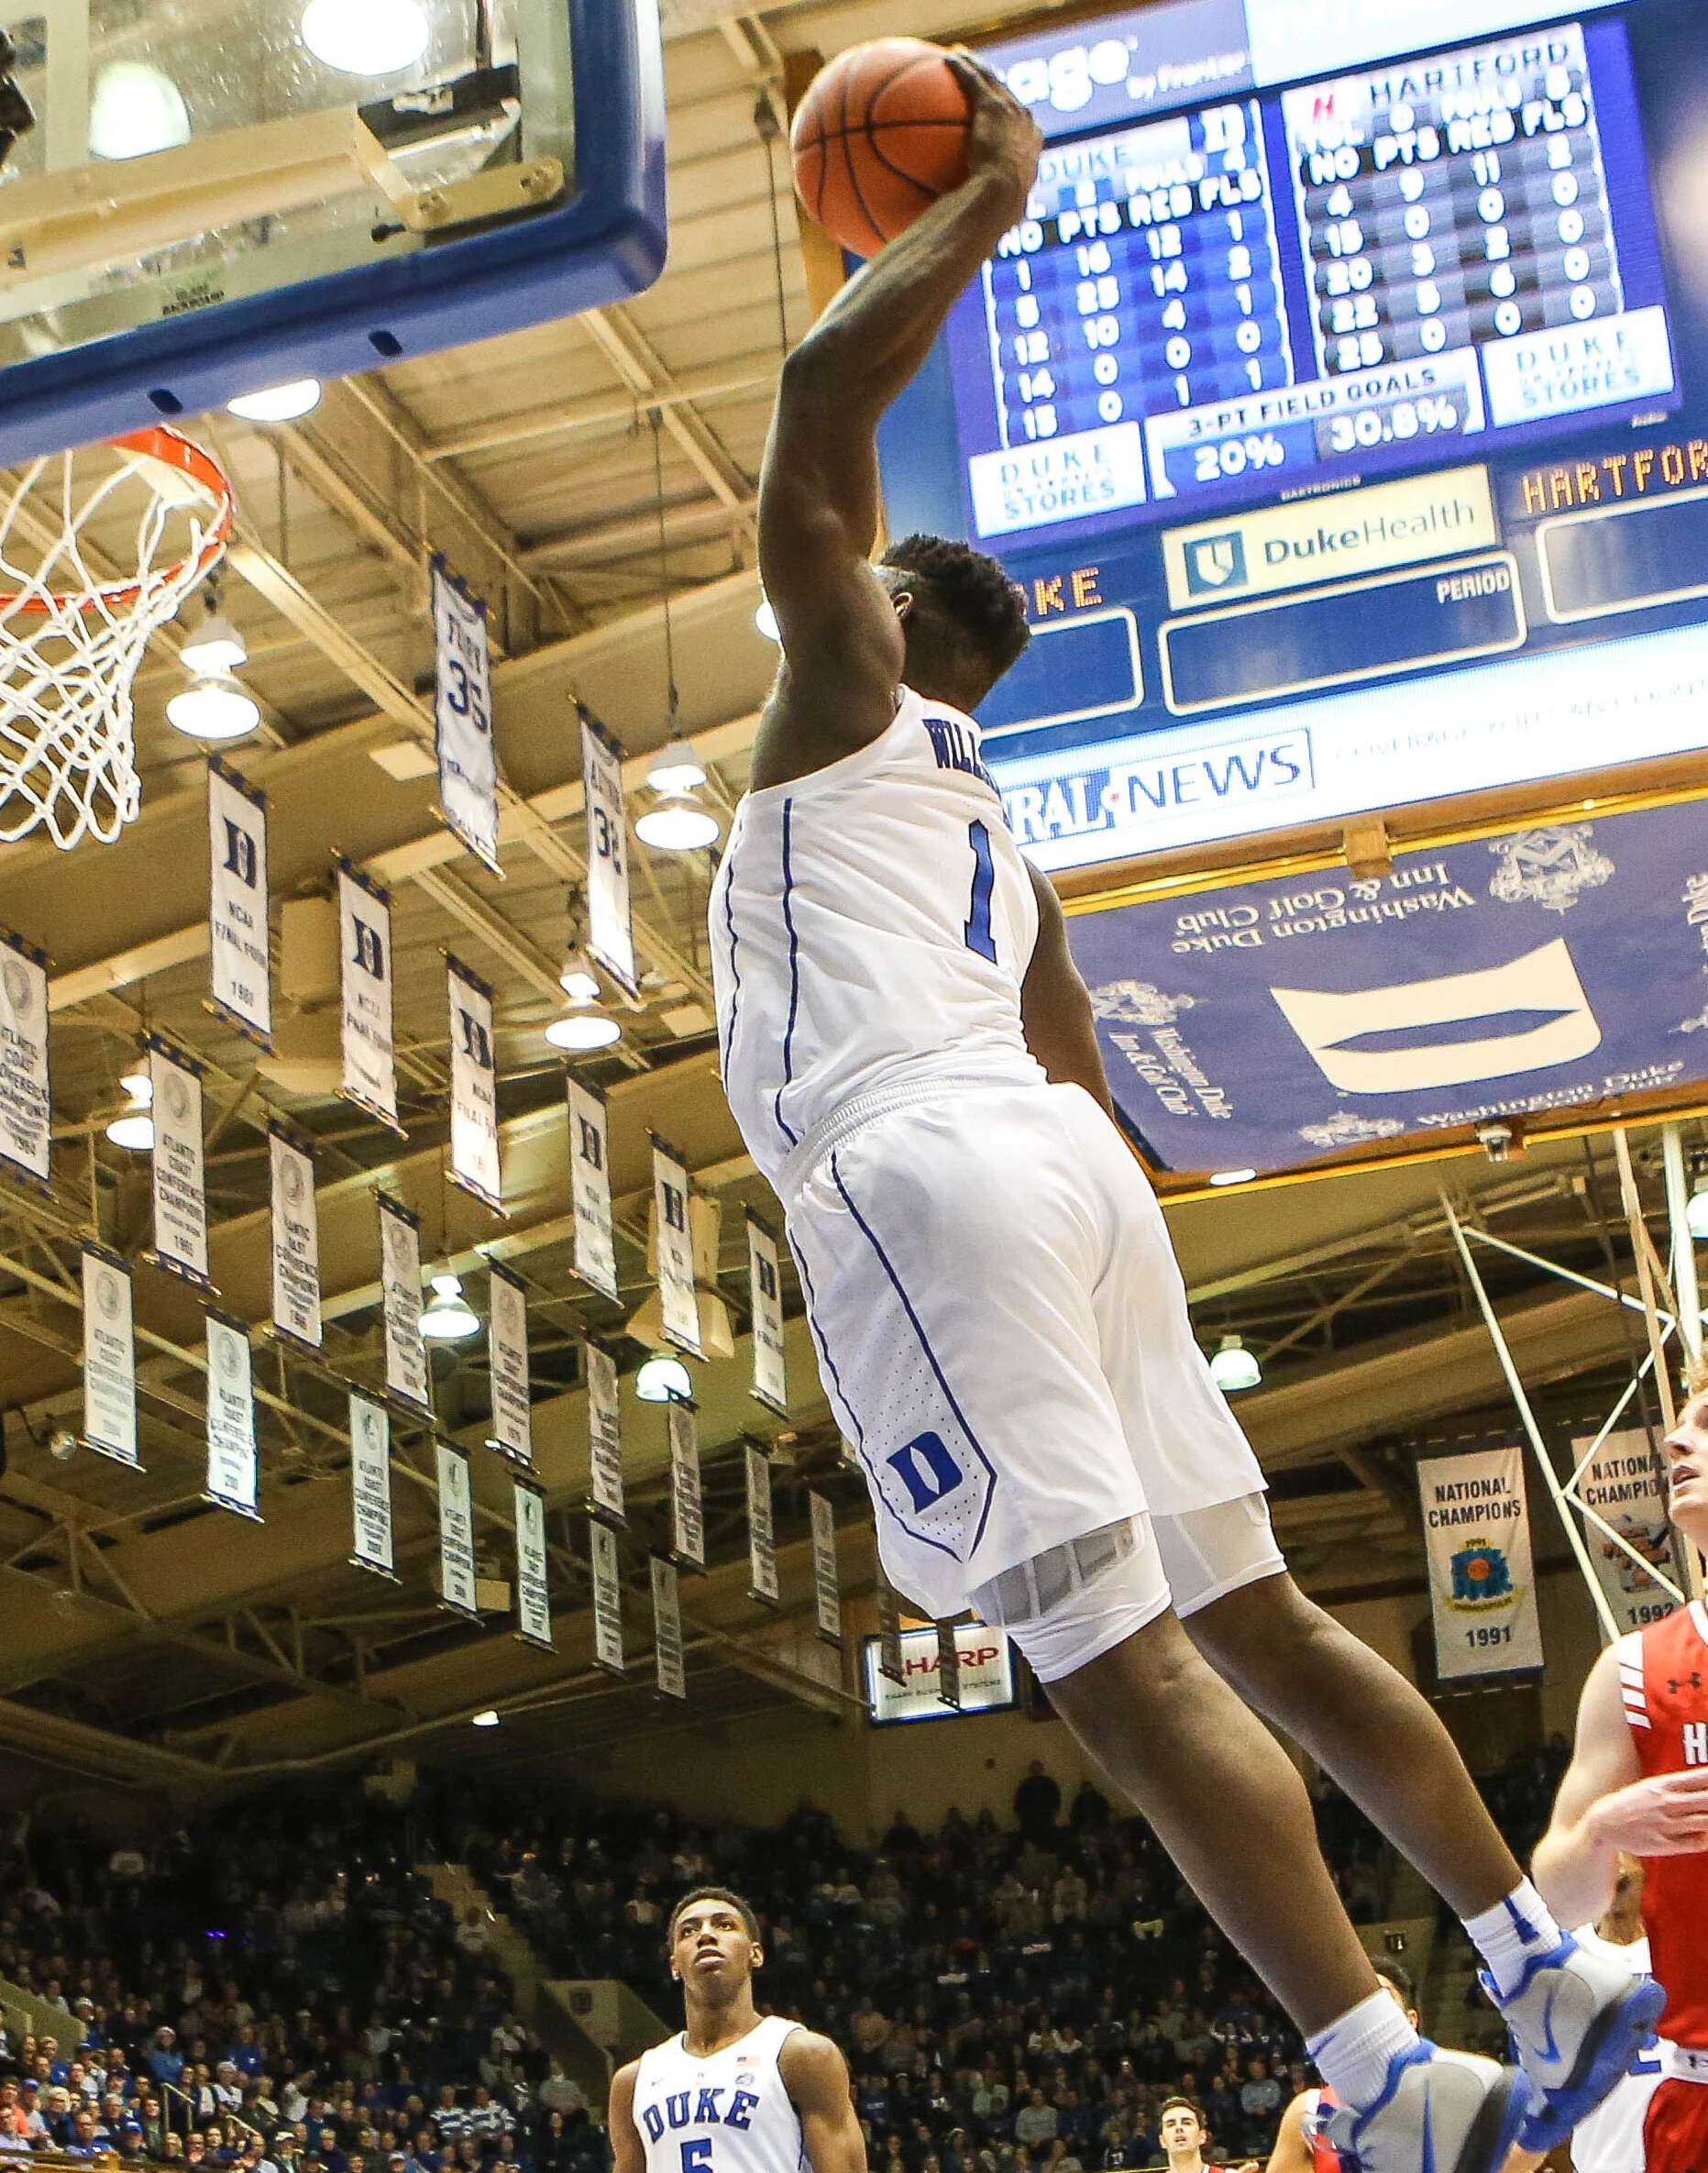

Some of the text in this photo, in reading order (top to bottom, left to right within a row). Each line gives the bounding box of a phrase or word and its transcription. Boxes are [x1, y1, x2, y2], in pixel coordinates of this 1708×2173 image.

[1370, 41, 1568, 101] HARTFORD
[1039, 143, 1131, 183] DUKE
[1308, 147, 1361, 185] NO
[1471, 151, 1502, 188] 11
[1404, 205, 1431, 240] 0
[1477, 187, 1506, 224] 0
[1552, 171, 1578, 207] 0
[1558, 208, 1585, 245] 0
[1018, 259, 1032, 292] 1
[1227, 210, 1244, 241] 1
[1563, 247, 1591, 282] 0
[1083, 314, 1119, 349] 10
[1162, 299, 1187, 330] 4
[1419, 316, 1447, 352] 0
[1494, 301, 1522, 336] 0
[1569, 283, 1597, 320] 0
[1017, 321, 1261, 403] 14 0 0 0
[1098, 391, 1123, 423] 0
[1175, 374, 1191, 407] 1
[1246, 358, 1262, 392] 1
[1190, 369, 1436, 437] 3-PT FIELD GOALS
[1195, 394, 1458, 481] 20% 30.8%
[1264, 500, 1475, 567] DukeHealth
[1015, 567, 1103, 617] KE
[1437, 568, 1510, 603] PERIOD
[1129, 744, 1301, 813] NEWS
[964, 818, 997, 965] 1
[1389, 863, 1451, 888] Inn
[1172, 886, 1477, 954] Washington Duke
[1268, 888, 1346, 921] Golf
[1428, 1499, 1522, 1528] CHAMPIONS
[1435, 1477, 1512, 1504] NATIONAL
[1465, 1626, 1511, 1648] 1991
[643, 2088, 760, 2145] DUKE
[680, 2138, 712, 2173] 5
